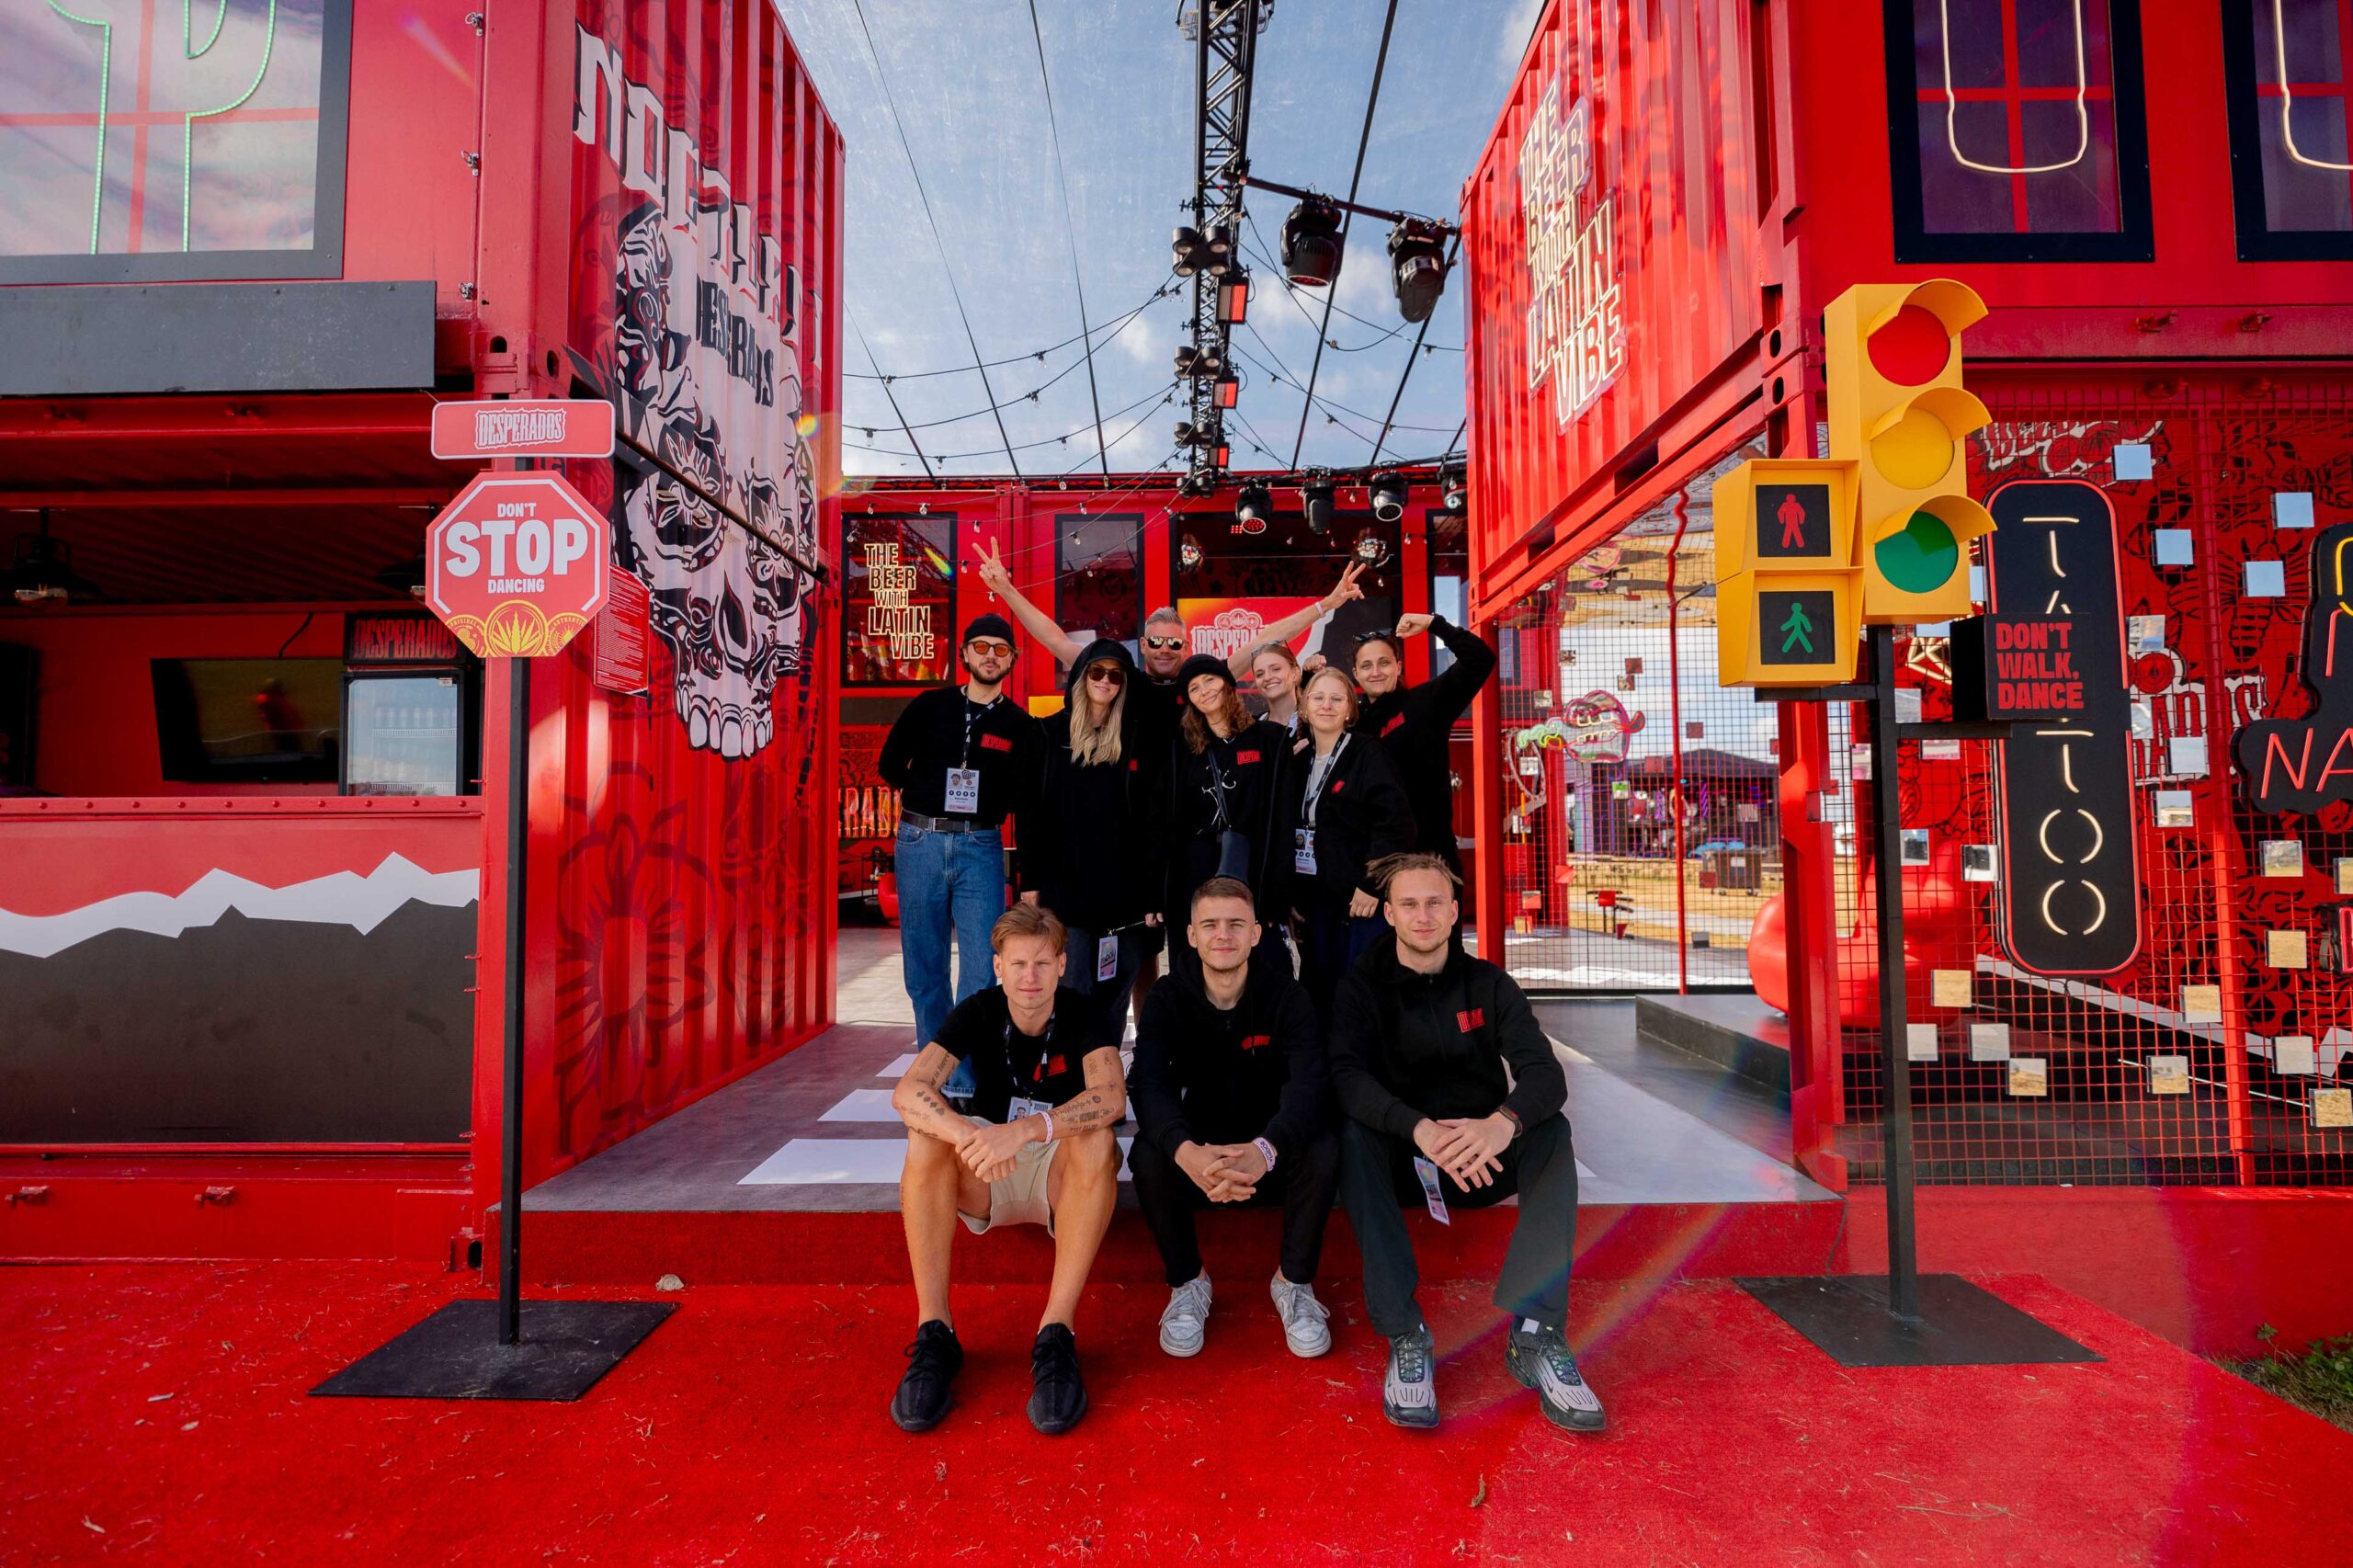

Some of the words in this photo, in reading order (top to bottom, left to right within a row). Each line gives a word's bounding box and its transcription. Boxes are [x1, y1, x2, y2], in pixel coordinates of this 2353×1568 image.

[1519, 79, 1559, 200] THE
[1526, 108, 1586, 264] BEER
[1532, 195, 1577, 301] WITH
[1528, 199, 1612, 389] LATIN
[1553, 284, 1621, 425] VIBE
[476, 410, 565, 449] DESPERADOS
[497, 503, 537, 517] DON'T
[446, 519, 588, 577] STOP
[864, 543, 898, 567] THE
[487, 578, 545, 594] DANCING
[869, 566, 916, 591] BEER
[875, 589, 908, 608] WITH
[868, 606, 930, 635] LATIN
[1995, 622, 2072, 650] DON'T
[353, 619, 457, 659] DESPERADOS
[891, 633, 934, 659] VIBE
[1998, 682, 2084, 710] DANCE
[2022, 517, 2106, 936] TTOO
